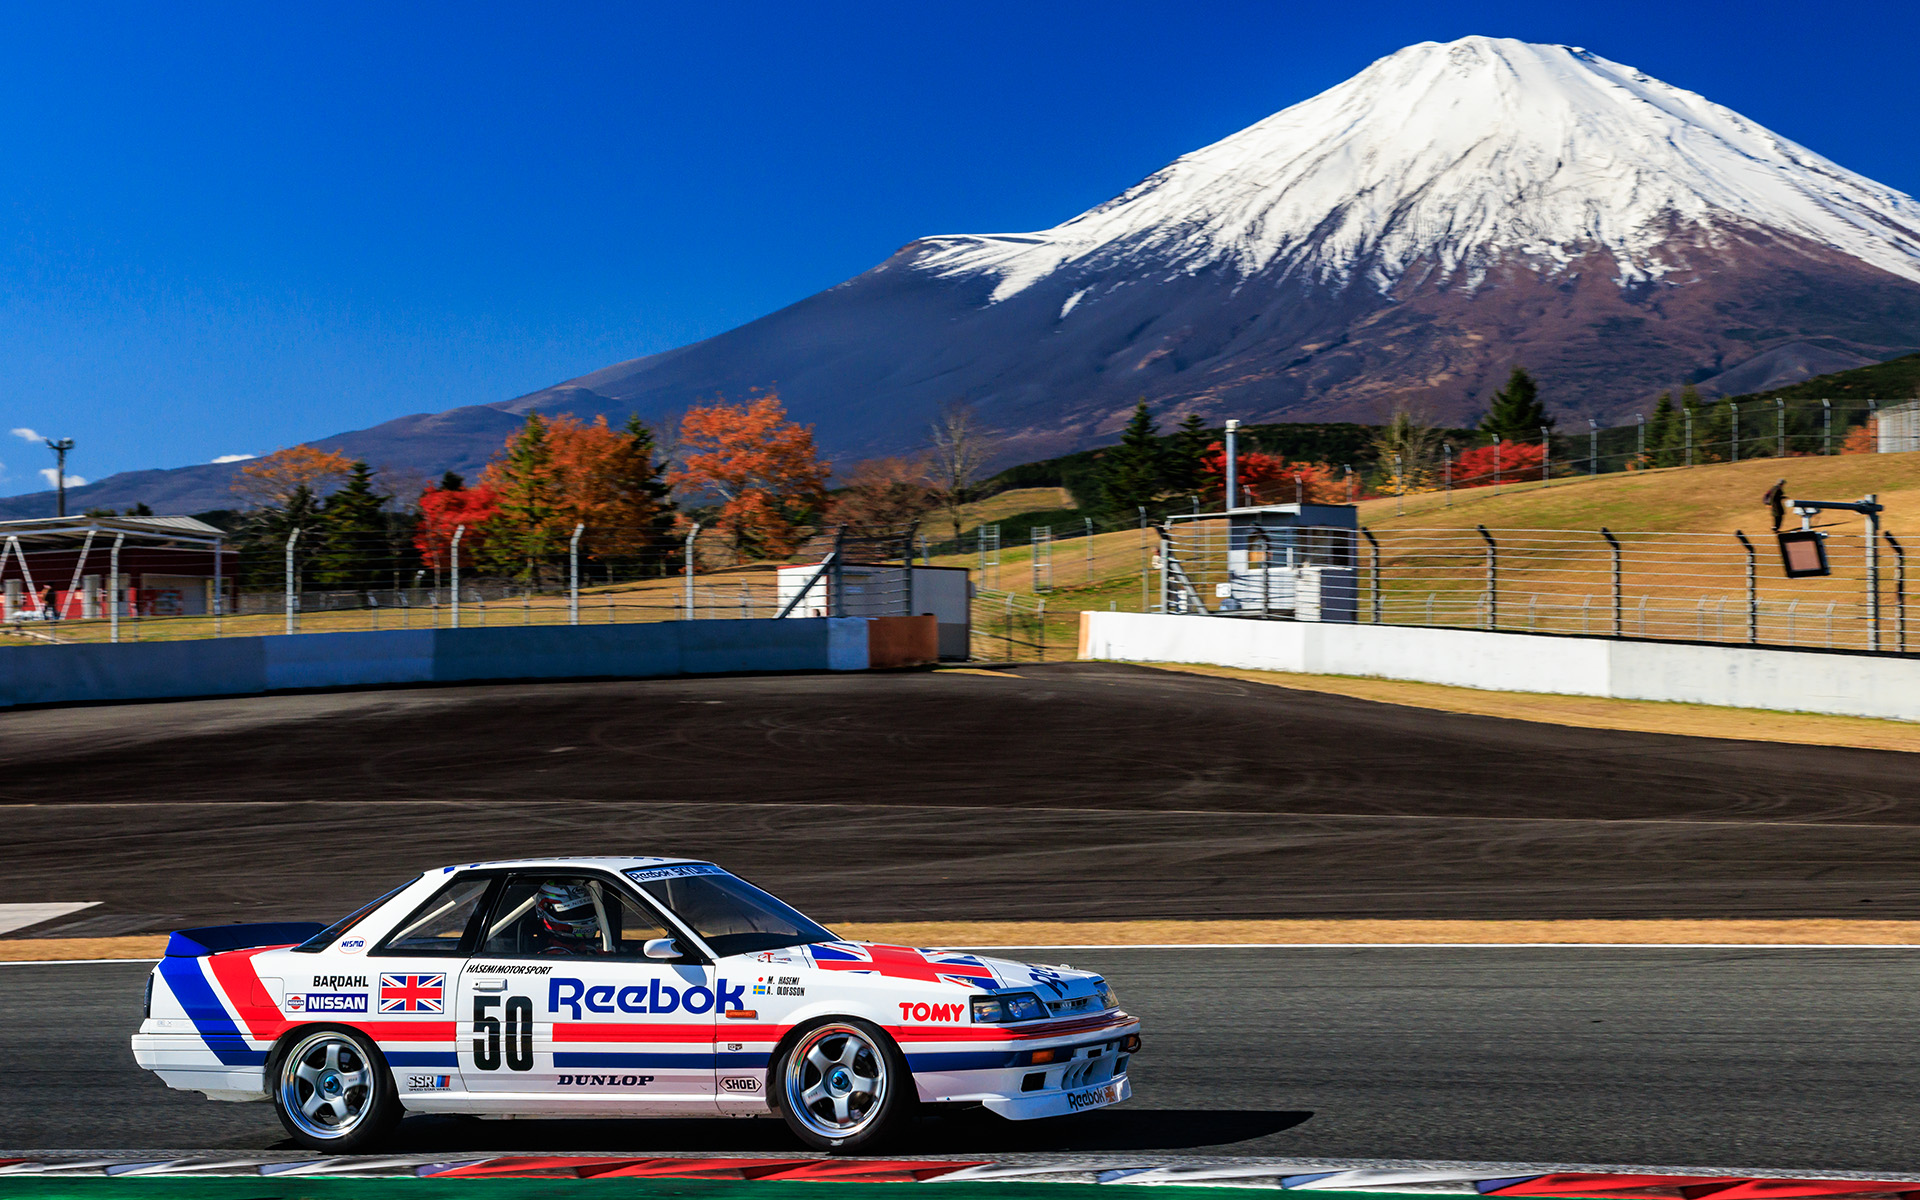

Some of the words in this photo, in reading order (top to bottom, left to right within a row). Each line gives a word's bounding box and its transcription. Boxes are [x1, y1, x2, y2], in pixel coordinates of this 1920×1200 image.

[630, 868, 671, 880] Reebok
[313, 975, 369, 991] BARDAHL
[778, 976, 800, 985] HASEMI
[777, 986, 805, 996] OLOFSSON
[308, 996, 366, 1010] NISSAN
[549, 978, 745, 1020] Reebok
[898, 1002, 965, 1022] TOMY
[472, 996, 534, 1071] 50
[408, 1075, 436, 1088] SSR
[557, 1075, 654, 1086] DUNLOP
[725, 1080, 757, 1090] SHOEI
[1067, 1088, 1106, 1111] Reebok
